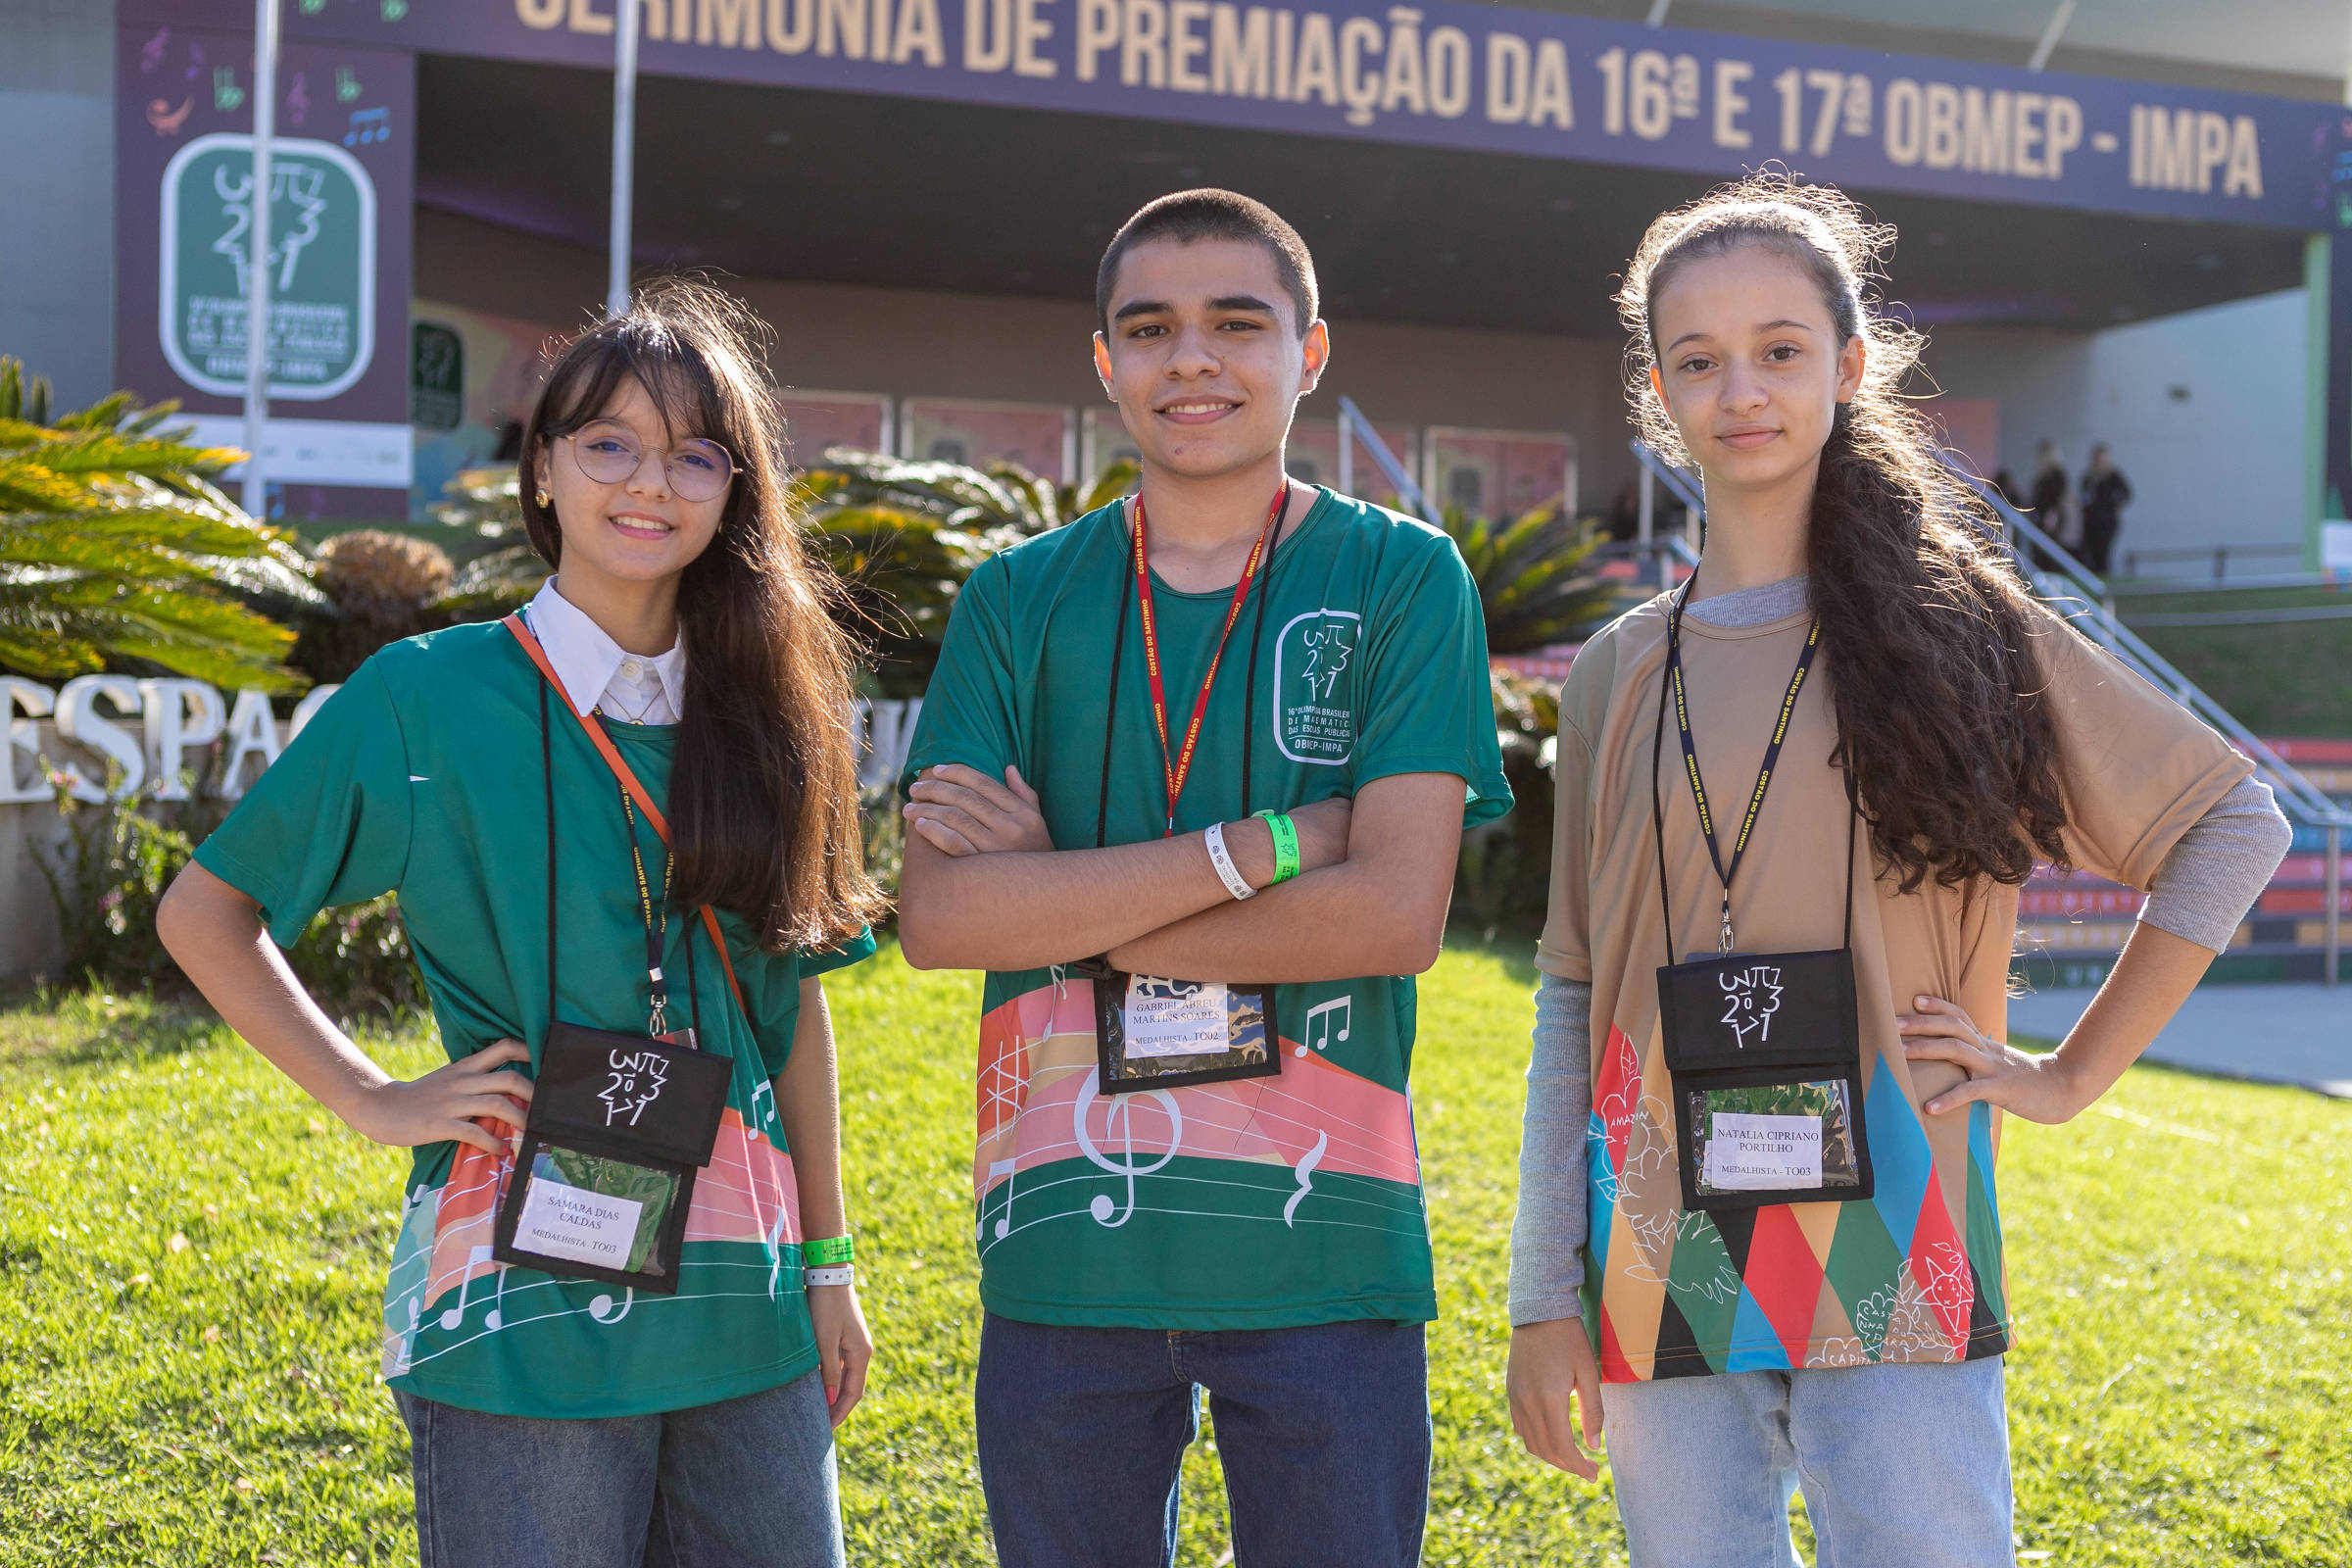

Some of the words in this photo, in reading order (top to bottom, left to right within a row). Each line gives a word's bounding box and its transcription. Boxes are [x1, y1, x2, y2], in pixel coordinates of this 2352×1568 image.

[962, 0, 1057, 77] DE
[1076, 0, 1471, 126] PREMIAÇÃO
[1486, 32, 1576, 130] DA
[1596, 47, 1700, 141] 16ª
[1713, 59, 1752, 149] E
[1773, 67, 1873, 157] 17ª
[1884, 77, 2082, 180] OBMEP
[2130, 103, 2264, 198] IMPA
[1288, 716, 1298, 725] DE
[1288, 725, 1298, 735] DAS
[1182, 751, 1190, 762] DO
[1137, 1001, 1177, 1011] GABRIEL
[1182, 999, 1216, 1009] ABREU
[1133, 1013, 1178, 1024] MARTINS
[1181, 1010, 1220, 1020] SOARES
[1718, 1129, 1764, 1140] NATALIA
[1767, 1131, 1819, 1142] CIPRIANO
[1740, 1143, 1793, 1152] PORTILHO
[1721, 1165, 1777, 1175] MEDALHISTA
[1784, 1166, 1811, 1176] TO03
[548, 1197, 593, 1215] SAMARA
[595, 1207, 619, 1221] DIAS
[560, 1212, 602, 1230] CALDAS
[531, 1228, 585, 1248] MEDALHISTA
[592, 1241, 617, 1253] TO03
[1860, 1320, 1885, 1331] NHA
